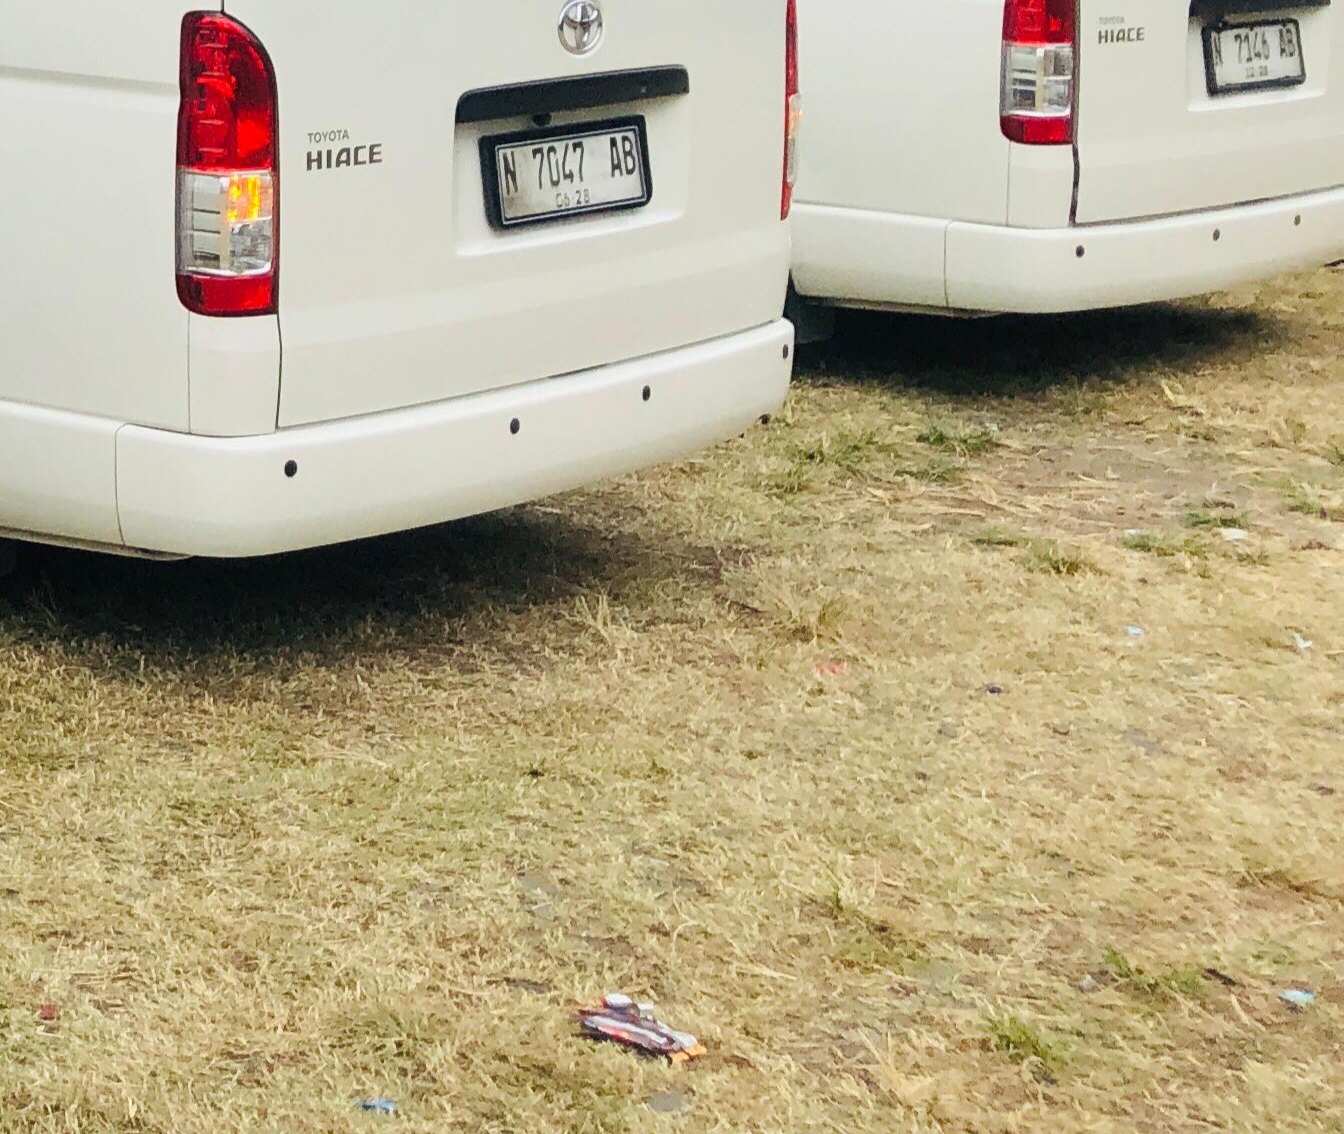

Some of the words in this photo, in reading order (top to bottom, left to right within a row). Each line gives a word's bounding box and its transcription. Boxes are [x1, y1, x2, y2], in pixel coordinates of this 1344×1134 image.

[1098, 27, 1145, 44] HIACE
[307, 129, 350, 143] TOYOTA
[306, 143, 383, 171] HIACE
[502, 151, 519, 195] N
[532, 140, 585, 190] 7047
[609, 135, 637, 178] AB
